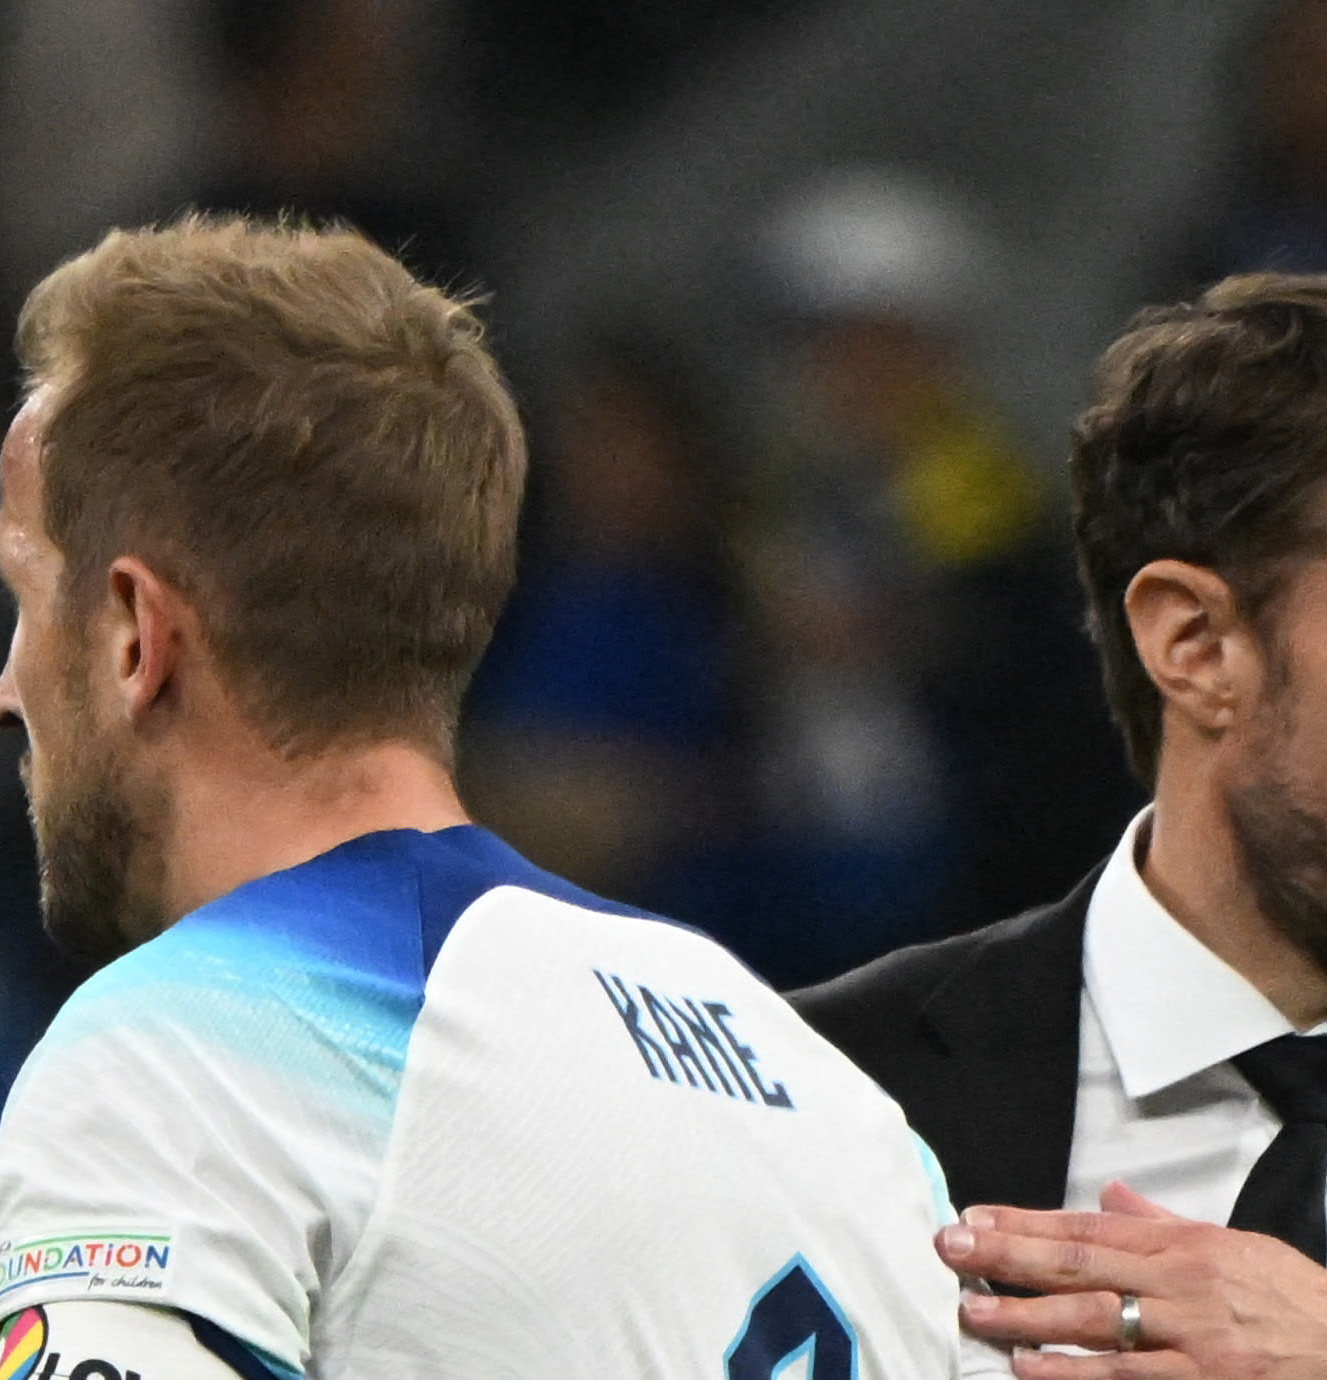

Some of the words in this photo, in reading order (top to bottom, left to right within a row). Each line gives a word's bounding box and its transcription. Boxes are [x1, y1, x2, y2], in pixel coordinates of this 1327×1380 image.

[592, 968, 795, 1111] KANE
[87, 1273, 105, 1291] for
[111, 1275, 162, 1289] children
